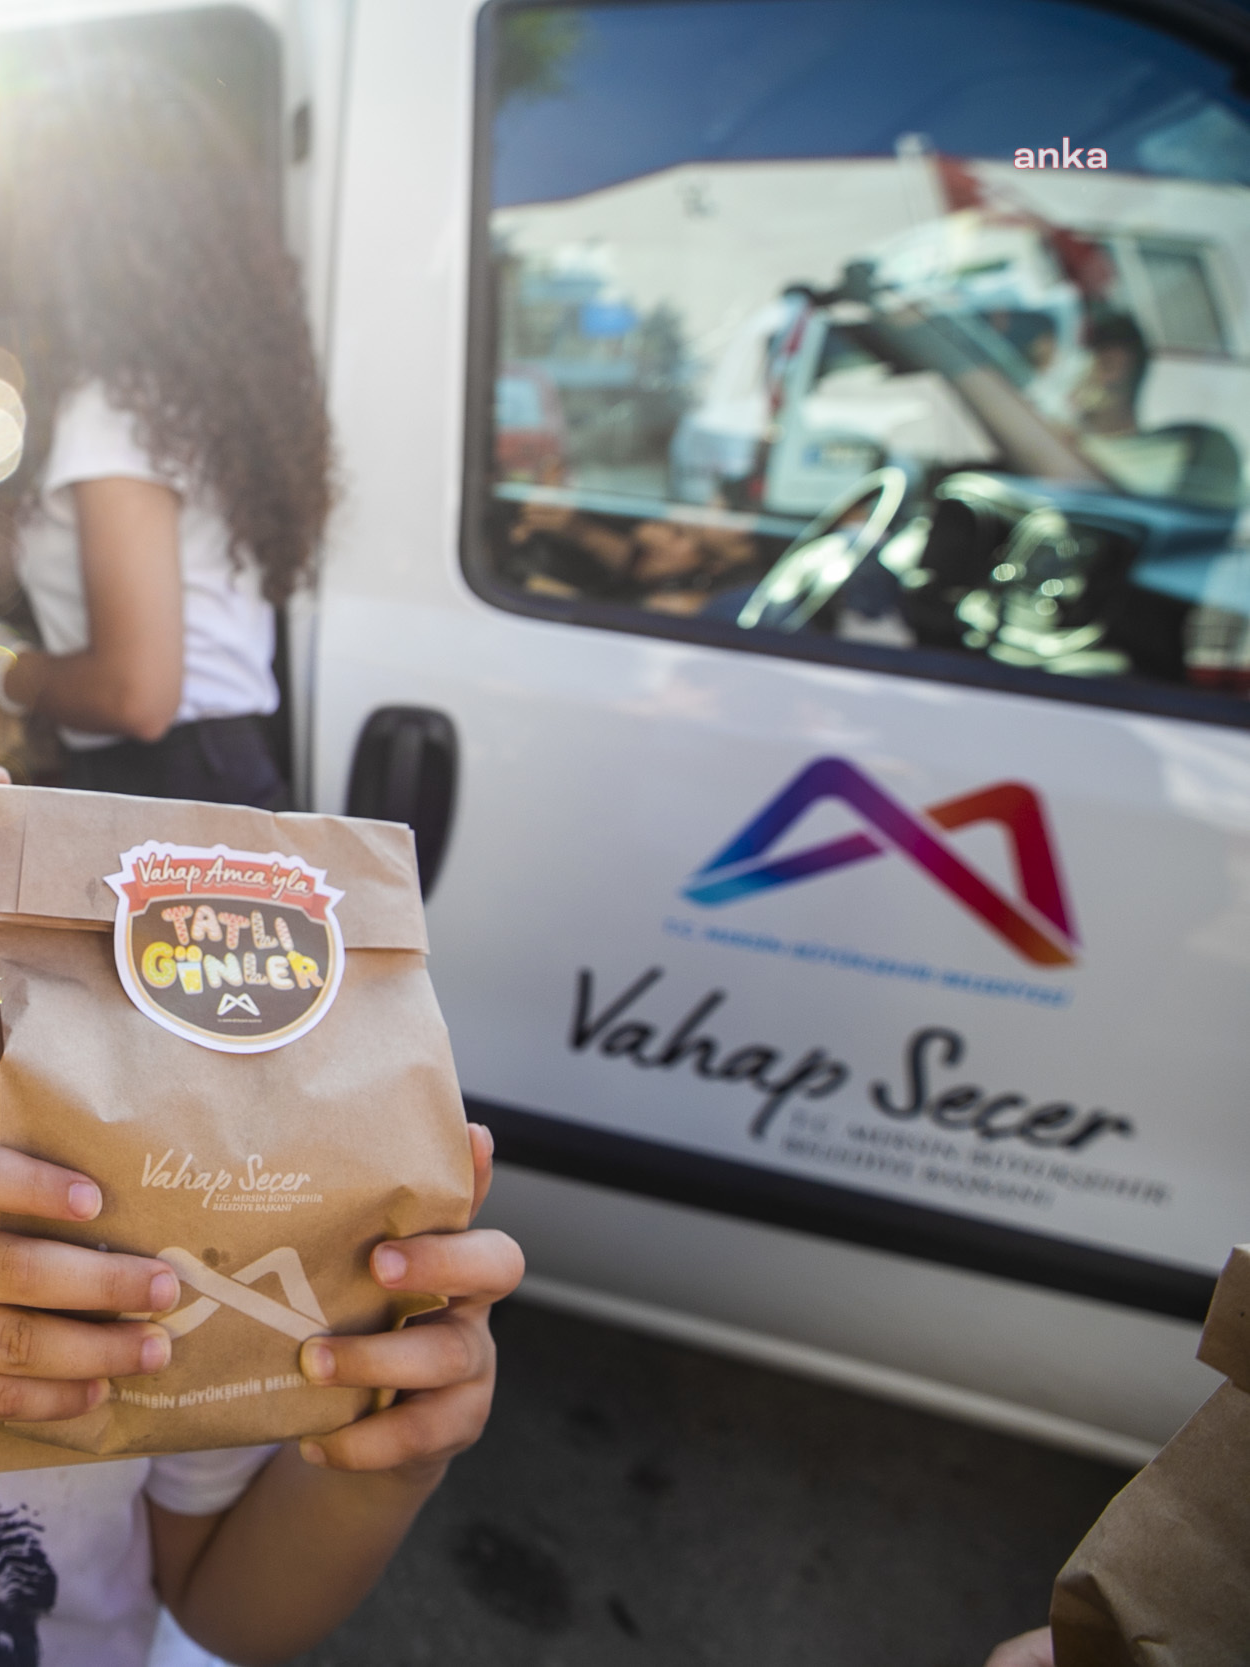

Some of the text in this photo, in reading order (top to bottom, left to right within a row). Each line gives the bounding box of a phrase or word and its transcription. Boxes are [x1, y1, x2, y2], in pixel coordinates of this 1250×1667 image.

[138, 852, 201, 892] Vahap
[161, 905, 294, 951] TATLI
[141, 941, 324, 995] GÜNLER
[568, 965, 851, 1141] Vahap
[141, 1148, 311, 1208] Vahap Seçer
[120, 1388, 176, 1409] MERSİN
[178, 1376, 262, 1408] BÜYÜKŞEHİR
